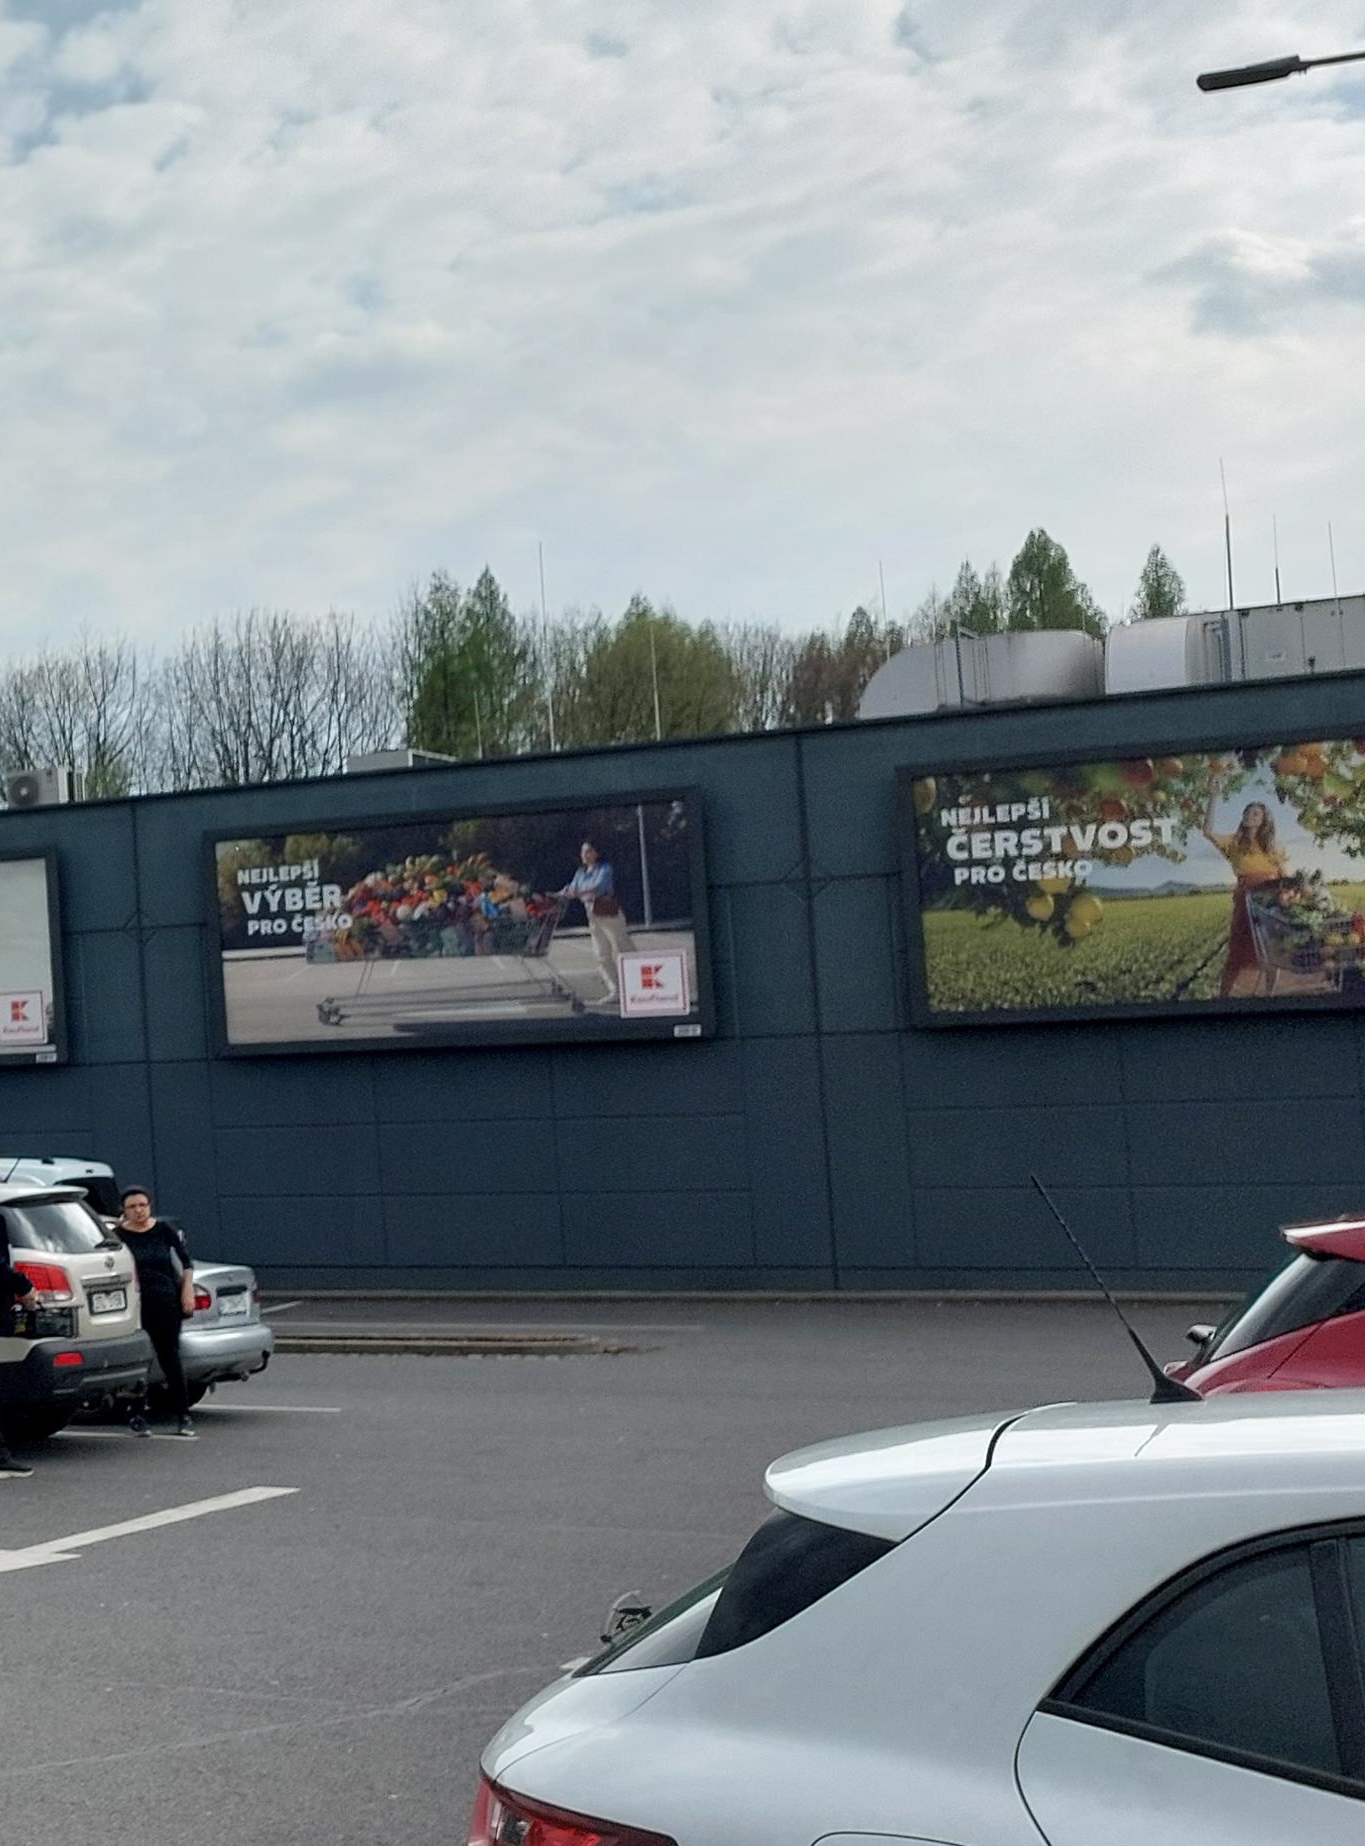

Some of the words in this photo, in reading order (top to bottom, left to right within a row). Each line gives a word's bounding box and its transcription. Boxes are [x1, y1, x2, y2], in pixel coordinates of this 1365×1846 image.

[940, 796, 1051, 828] NEJLEPŠÍ
[946, 817, 1176, 861] ČERSTVOST
[237, 857, 319, 886] NEJLEPŠÍ
[954, 863, 1006, 886] PRO
[1013, 858, 1094, 883] ČESKO
[241, 880, 344, 915] VÝBĚR
[247, 917, 287, 936] PRO
[291, 911, 353, 933] ČESKO
